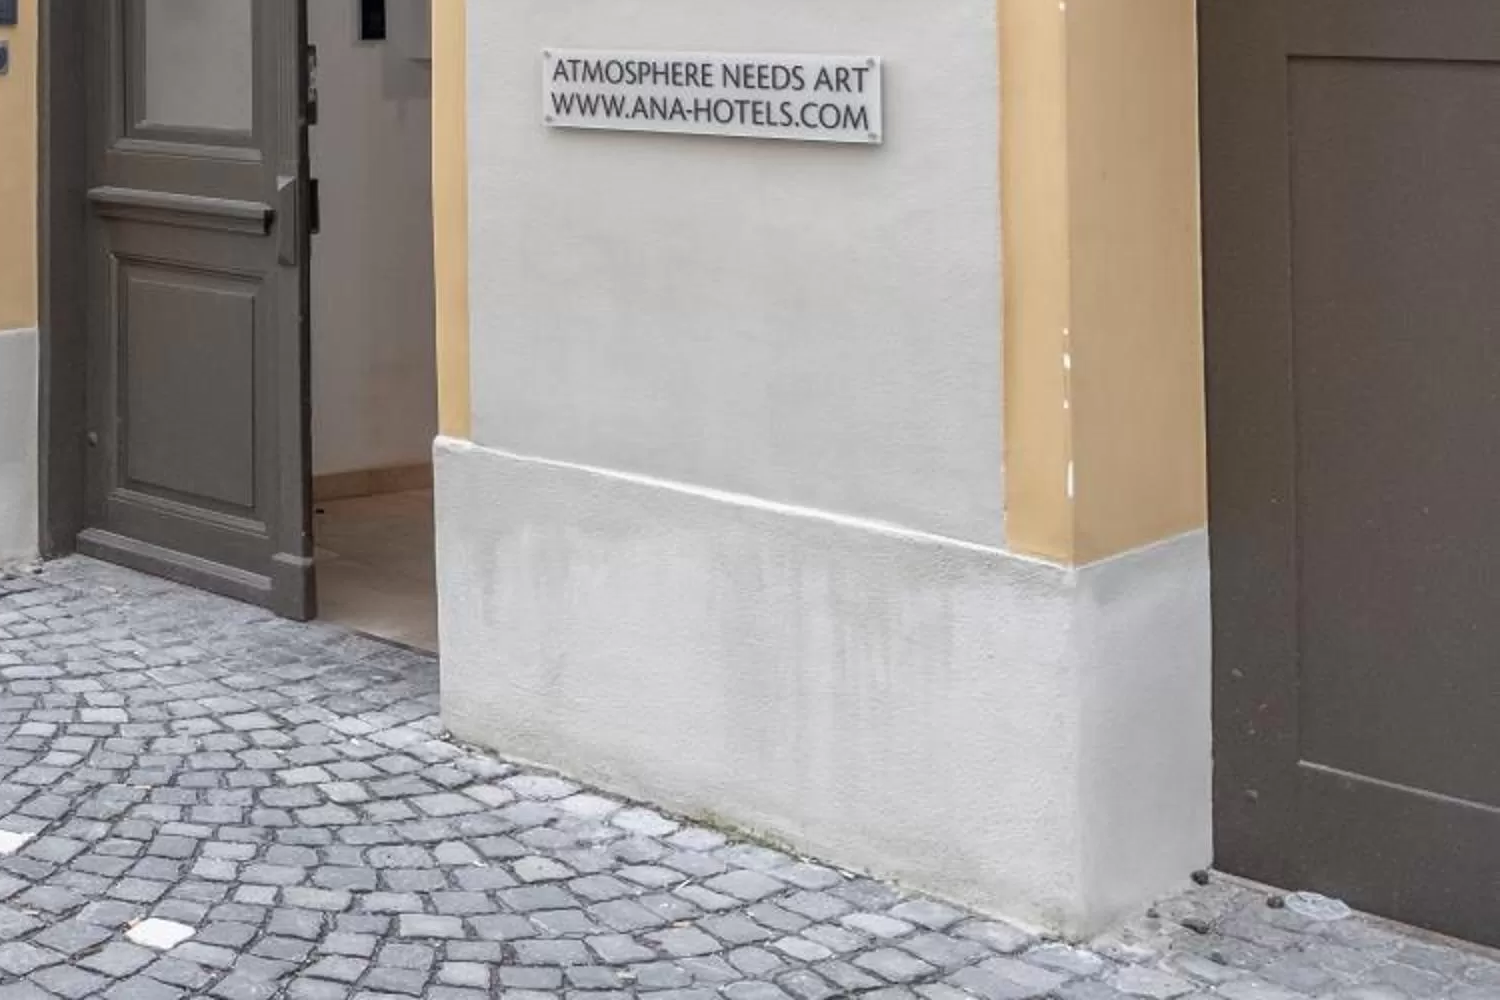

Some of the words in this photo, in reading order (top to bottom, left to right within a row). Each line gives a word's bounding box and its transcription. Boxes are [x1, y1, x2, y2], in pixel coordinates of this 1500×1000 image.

[552, 59, 714, 88] ATMOSPHERE
[721, 63, 805, 92] NEEDS
[813, 66, 870, 94] ART
[550, 91, 870, 131] WWW.ANA-HOTELS.COM
